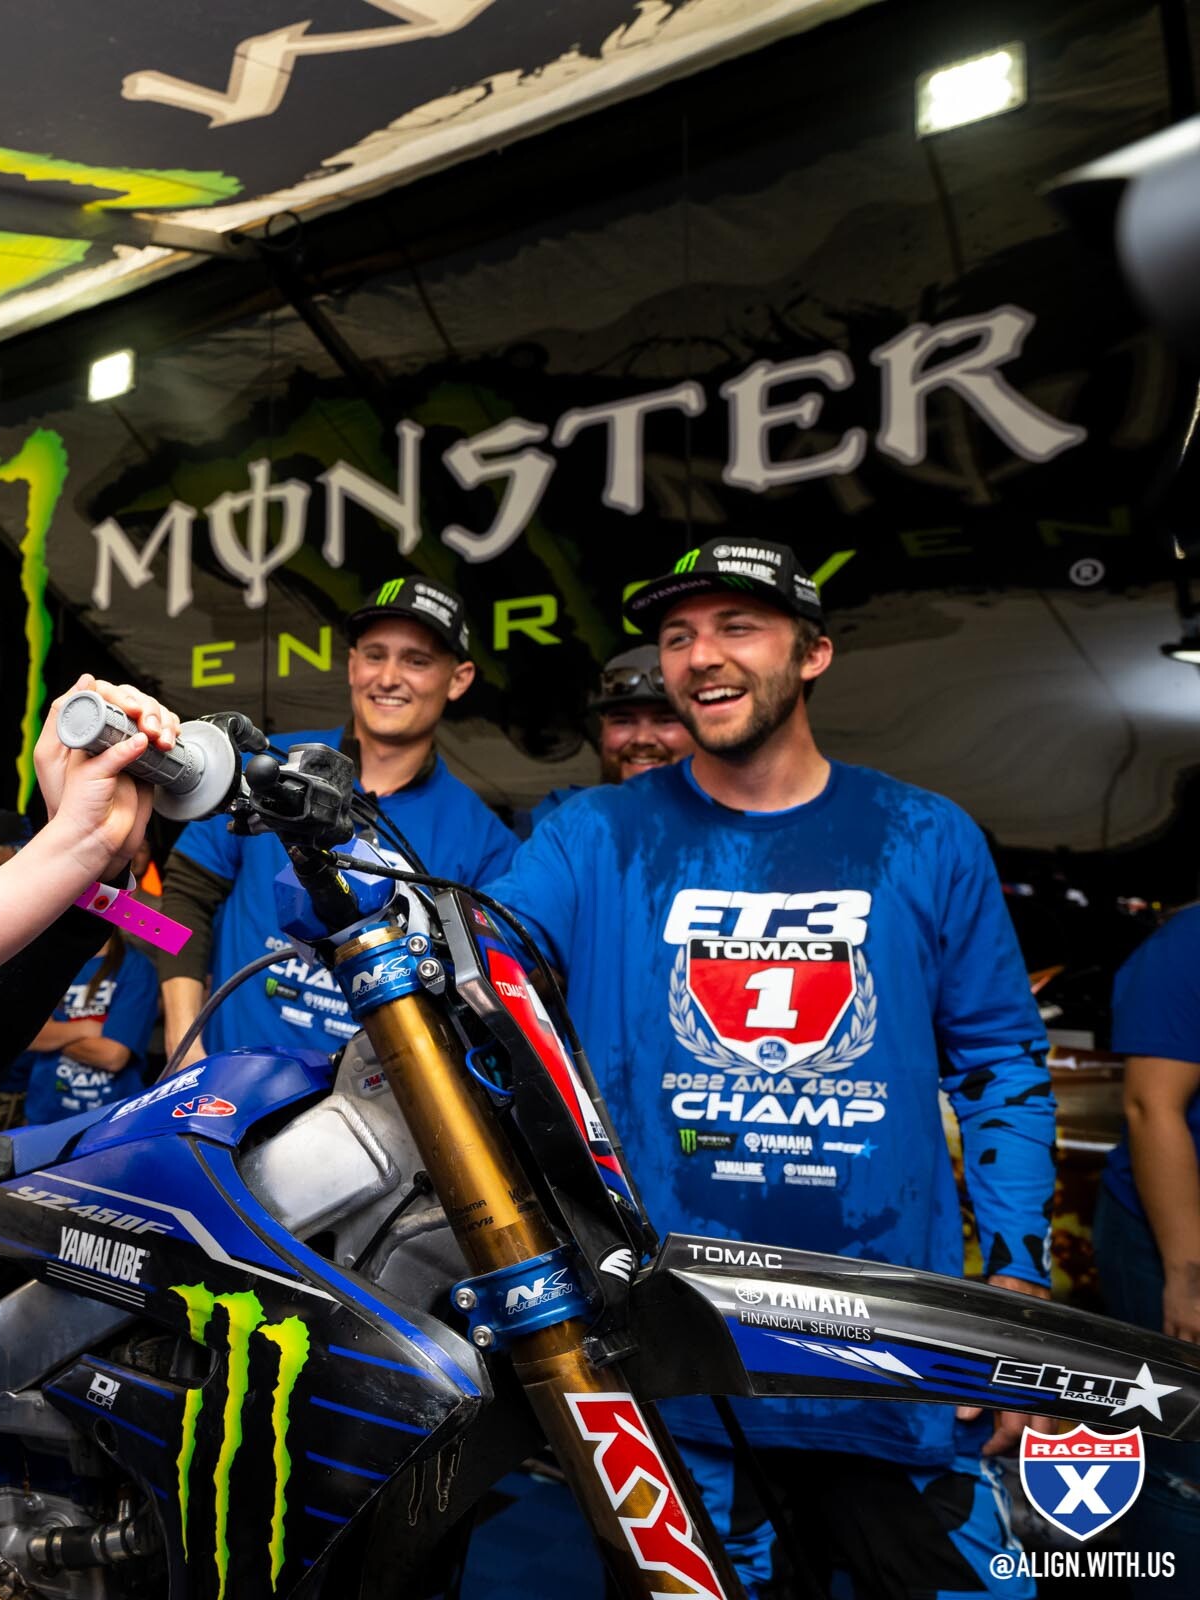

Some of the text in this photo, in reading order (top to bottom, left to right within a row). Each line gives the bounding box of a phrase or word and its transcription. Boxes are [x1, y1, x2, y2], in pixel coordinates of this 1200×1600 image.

[730, 546, 782, 566] YAMAHA
[663, 888, 873, 945] ET3
[702, 940, 833, 961] TOMAC
[496, 981, 527, 1000] TOMAC
[745, 968, 798, 1029] 1
[662, 1073, 888, 1099] 2022 AMA 450SX
[671, 1091, 886, 1127] CHAMP
[760, 1134, 814, 1150] YAMAHA
[6, 1184, 174, 1236] YZ450F
[58, 1226, 146, 1285] YAMALUBE
[688, 1244, 782, 1269] TOMAC
[507, 1282, 574, 1315] NEKEN
[767, 1285, 870, 1319] YAMAHA
[740, 1310, 872, 1341] FINANCIAL SERVICES
[1064, 1390, 1127, 1407] RACING
